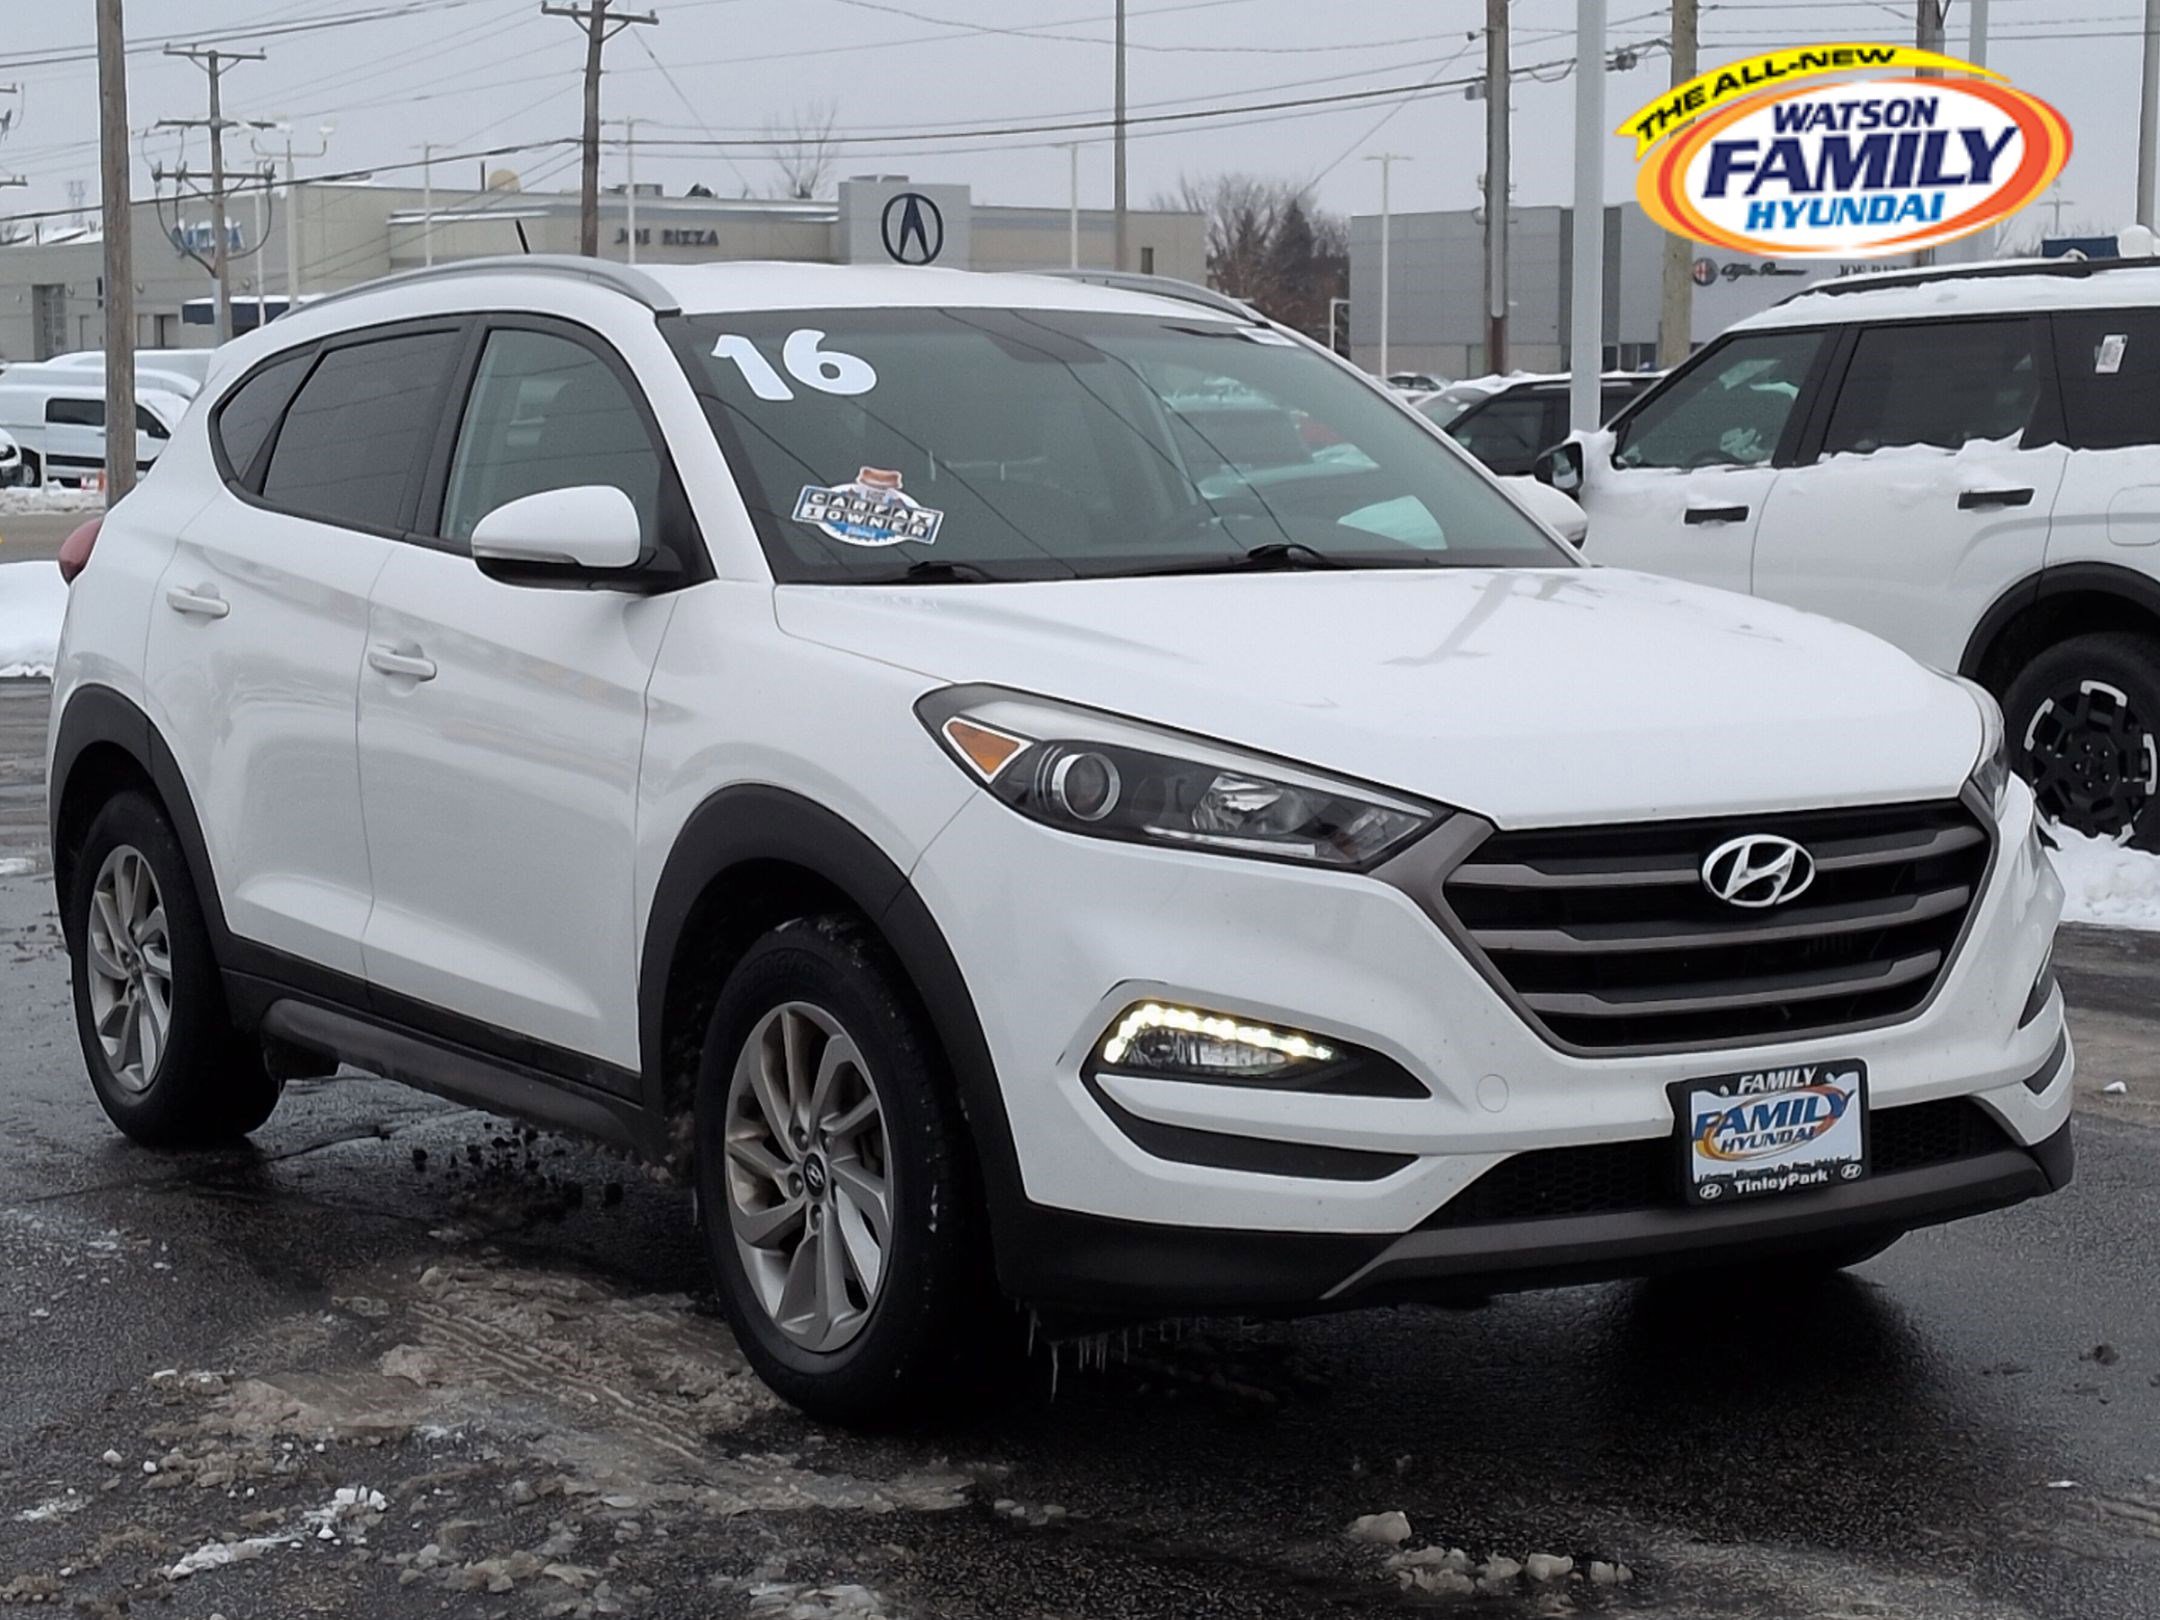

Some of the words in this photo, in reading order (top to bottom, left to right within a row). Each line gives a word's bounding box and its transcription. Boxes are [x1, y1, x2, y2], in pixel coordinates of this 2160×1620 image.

[711, 329, 877, 401] 16
[811, 493, 931, 526] CARFAX
[826, 510, 926, 537] OWNER
[1737, 1066, 1817, 1095] FAMILY
[1693, 1090, 1856, 1141] FAMILY
[1720, 1126, 1817, 1153] HYUNDAI
[1734, 1169, 1829, 1194] TinleyPark
